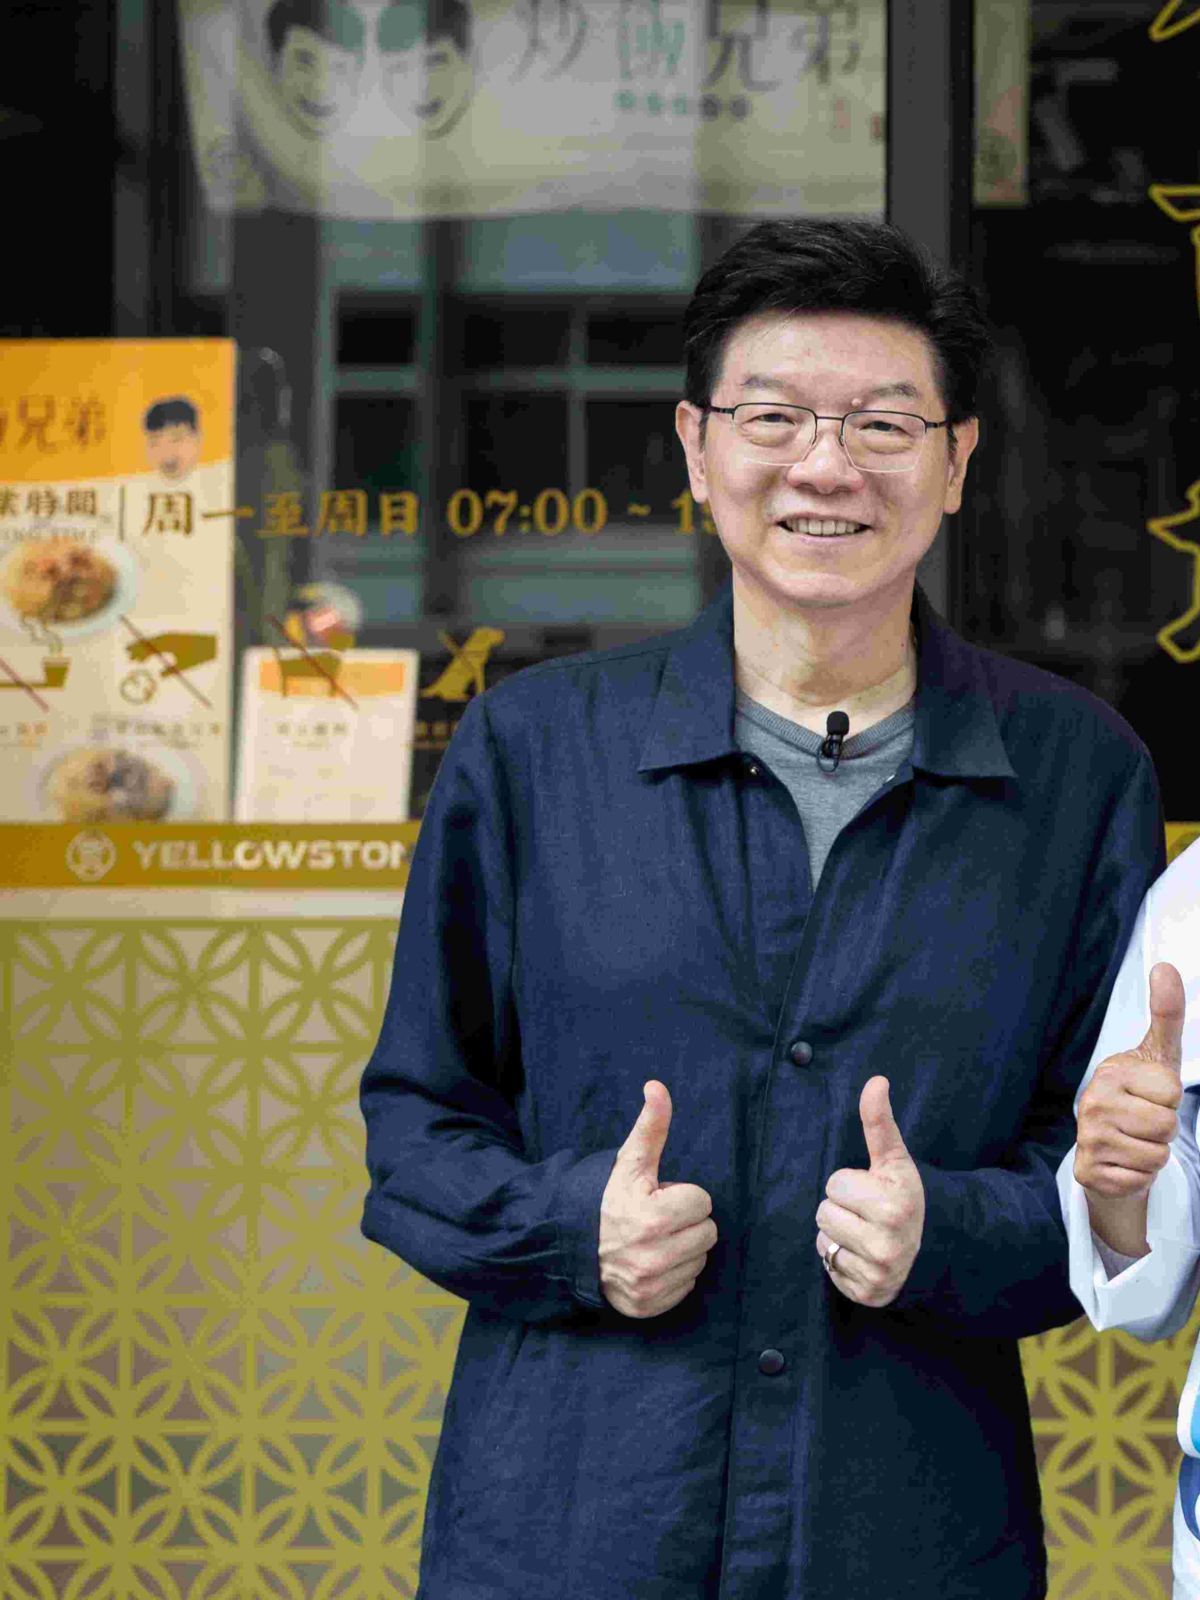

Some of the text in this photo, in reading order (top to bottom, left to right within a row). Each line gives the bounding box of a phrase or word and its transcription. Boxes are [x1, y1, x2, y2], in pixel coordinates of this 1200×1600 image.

[0, 393, 107, 452] 兄弟
[142, 488, 419, 538] 周一至周日
[447, 488, 609, 537] 07:00
